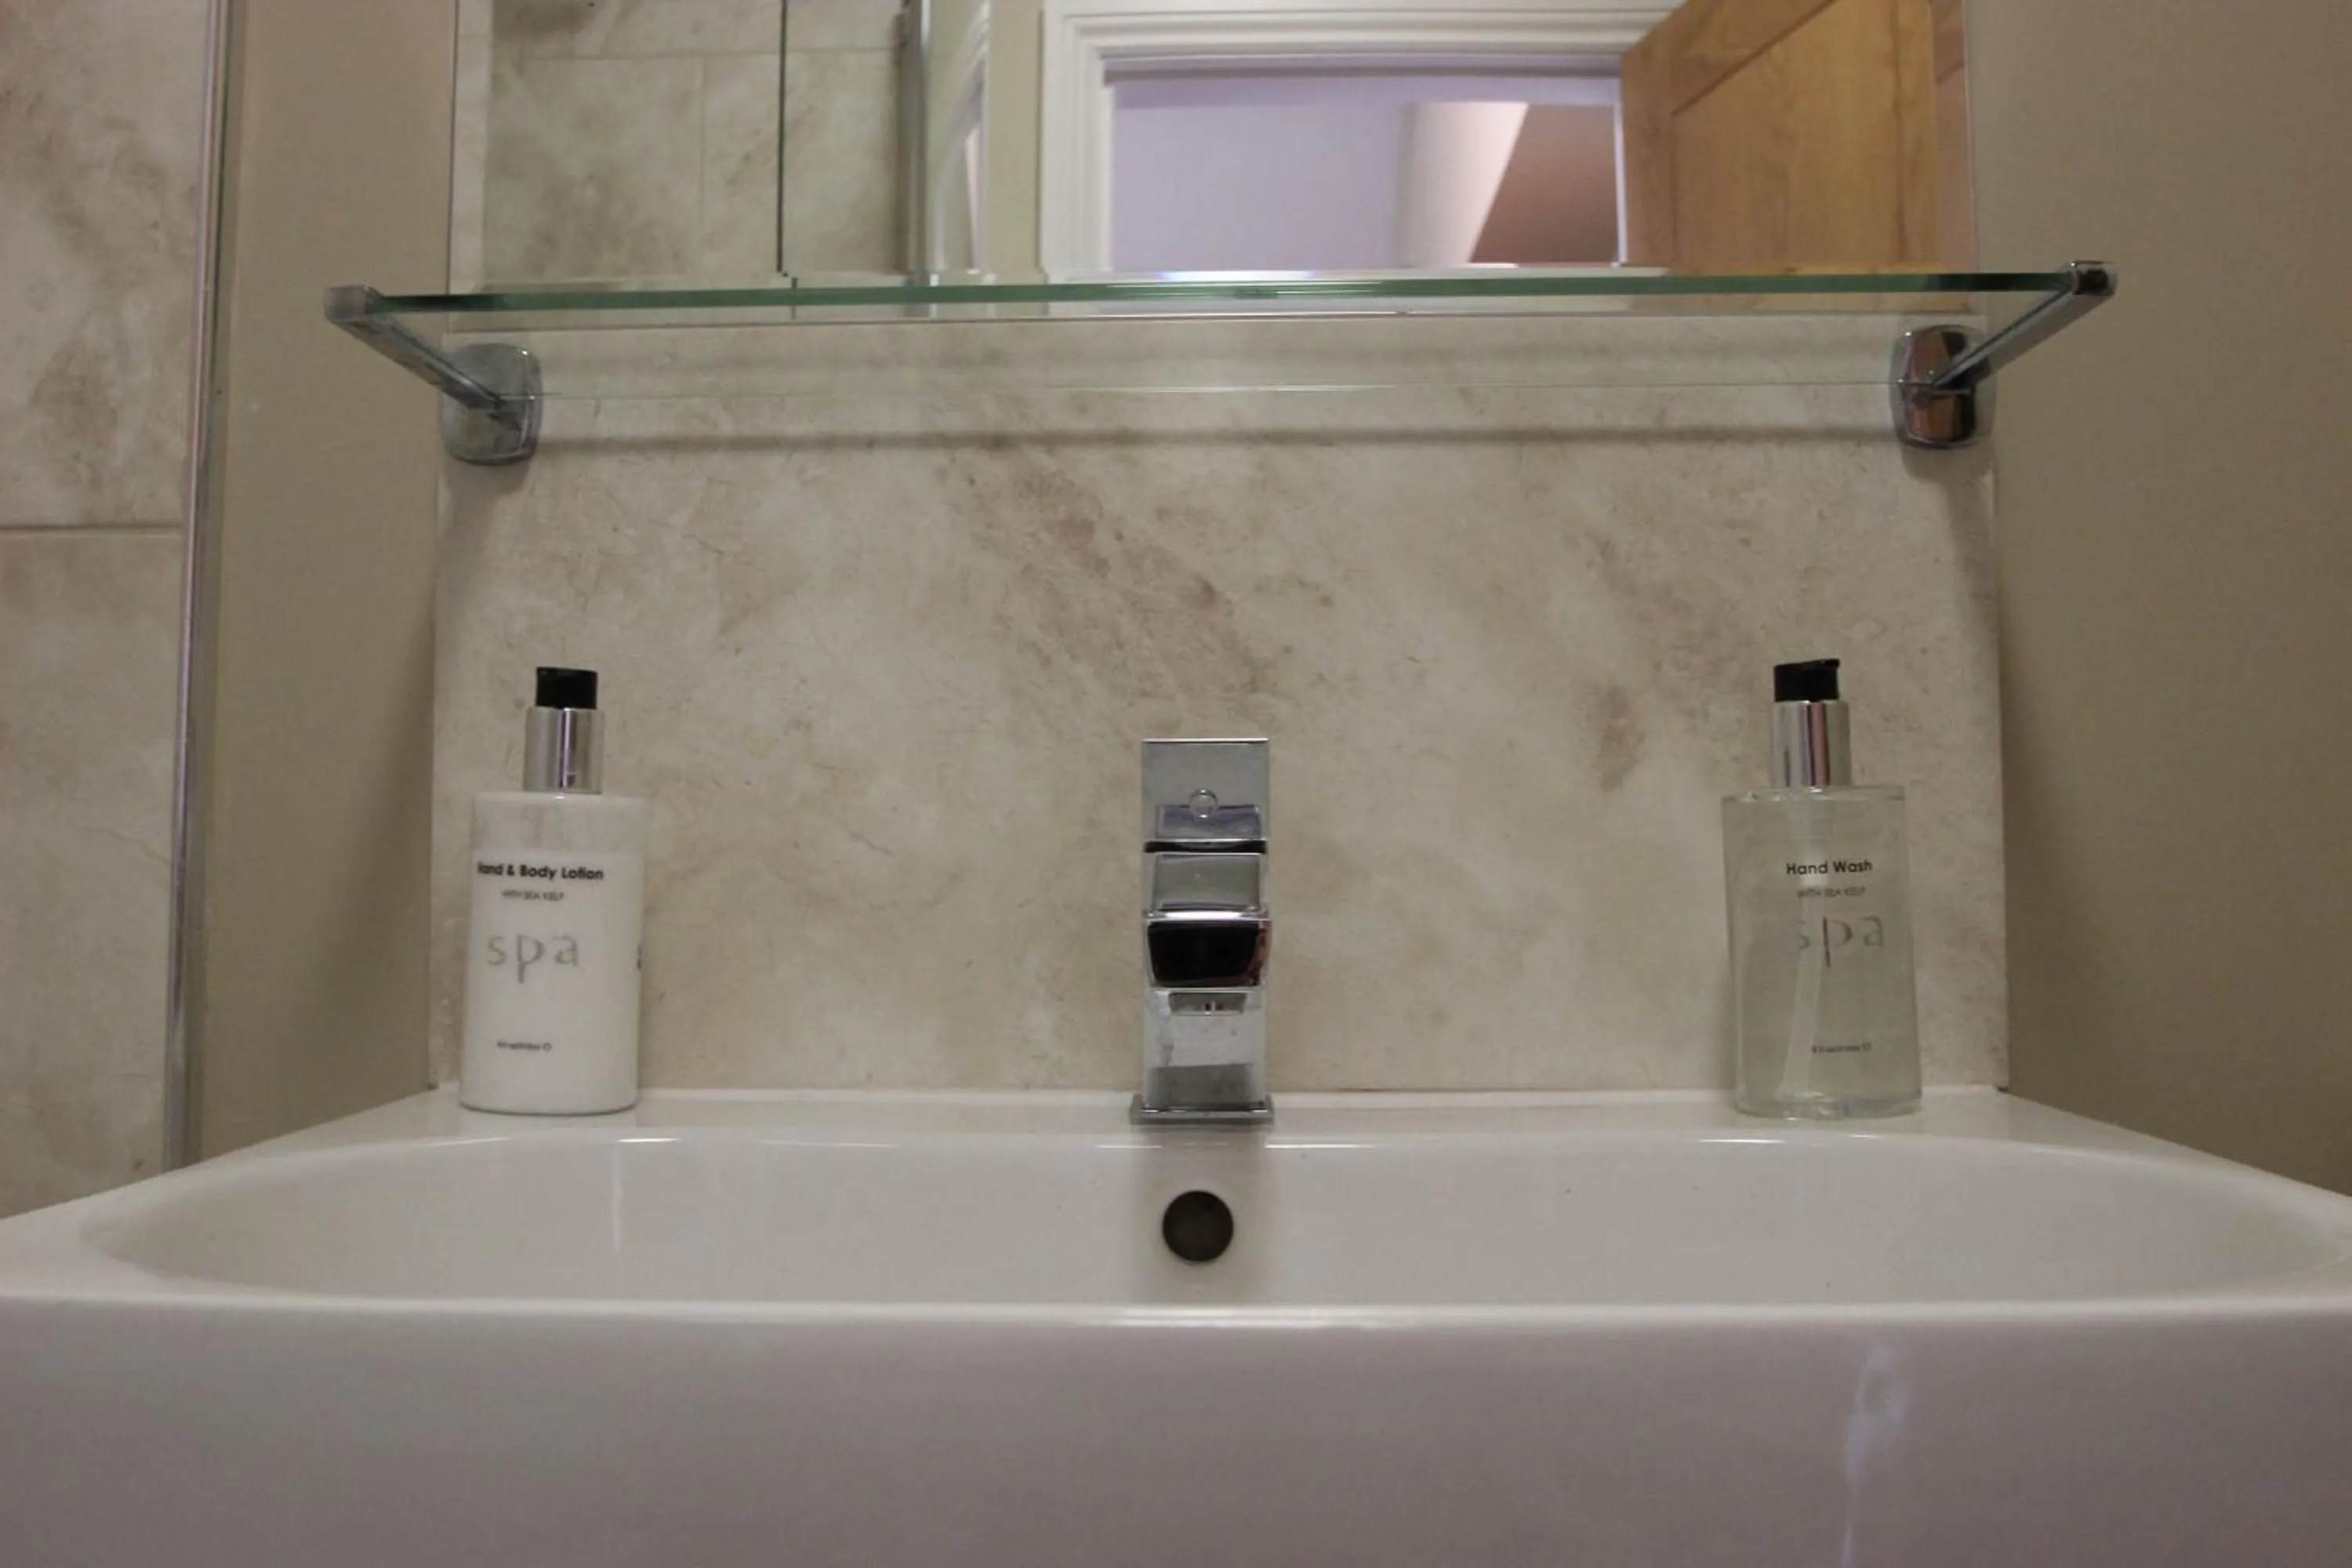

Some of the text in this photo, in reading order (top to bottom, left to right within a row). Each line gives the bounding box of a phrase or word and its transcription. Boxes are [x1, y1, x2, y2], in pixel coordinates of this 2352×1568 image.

[520, 864, 557, 880] Body
[561, 866, 604, 879] Lotion
[1786, 859, 1873, 875] Hand Wash
[487, 933, 579, 983] spa
